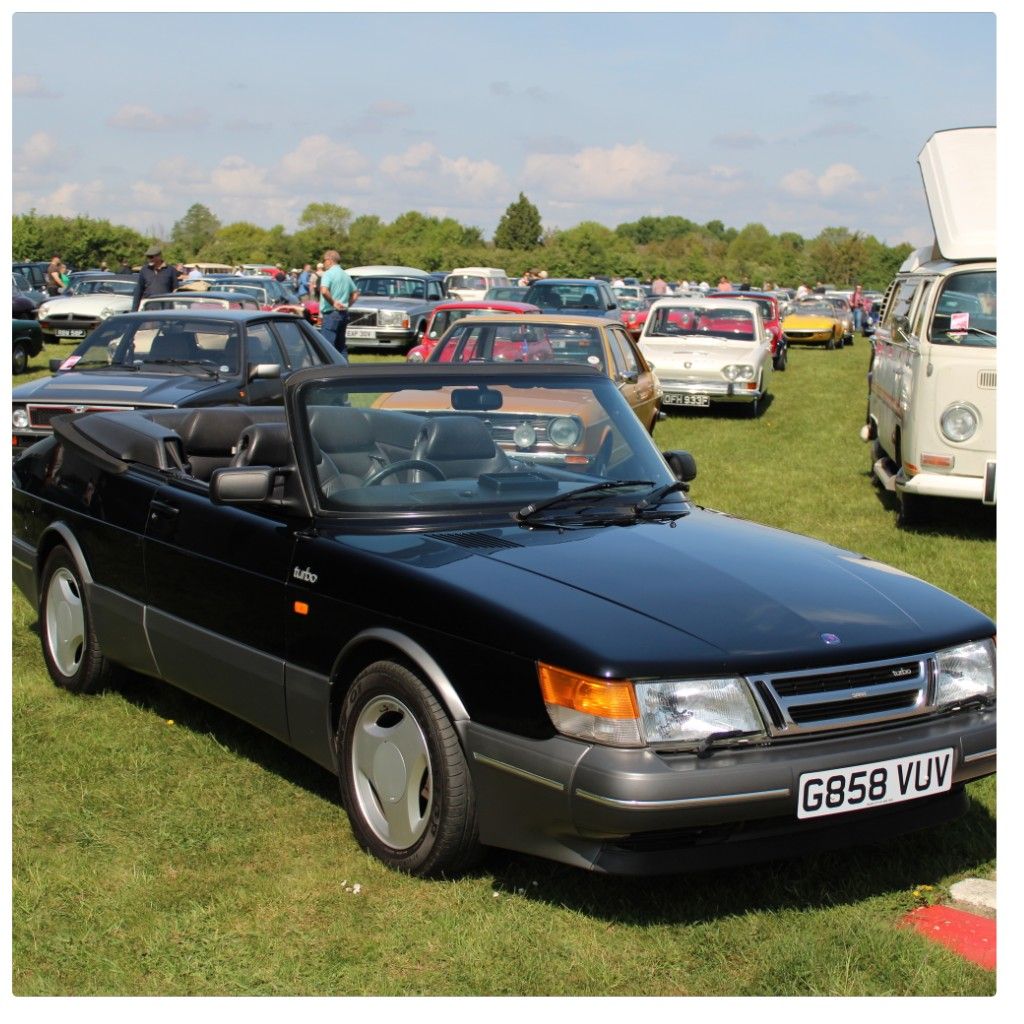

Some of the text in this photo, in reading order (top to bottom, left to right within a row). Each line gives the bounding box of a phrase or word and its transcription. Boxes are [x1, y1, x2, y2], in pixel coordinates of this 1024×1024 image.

[293, 566, 318, 583] turbo
[892, 667, 912, 676] turbo
[803, 754, 950, 812] G858 VUV
